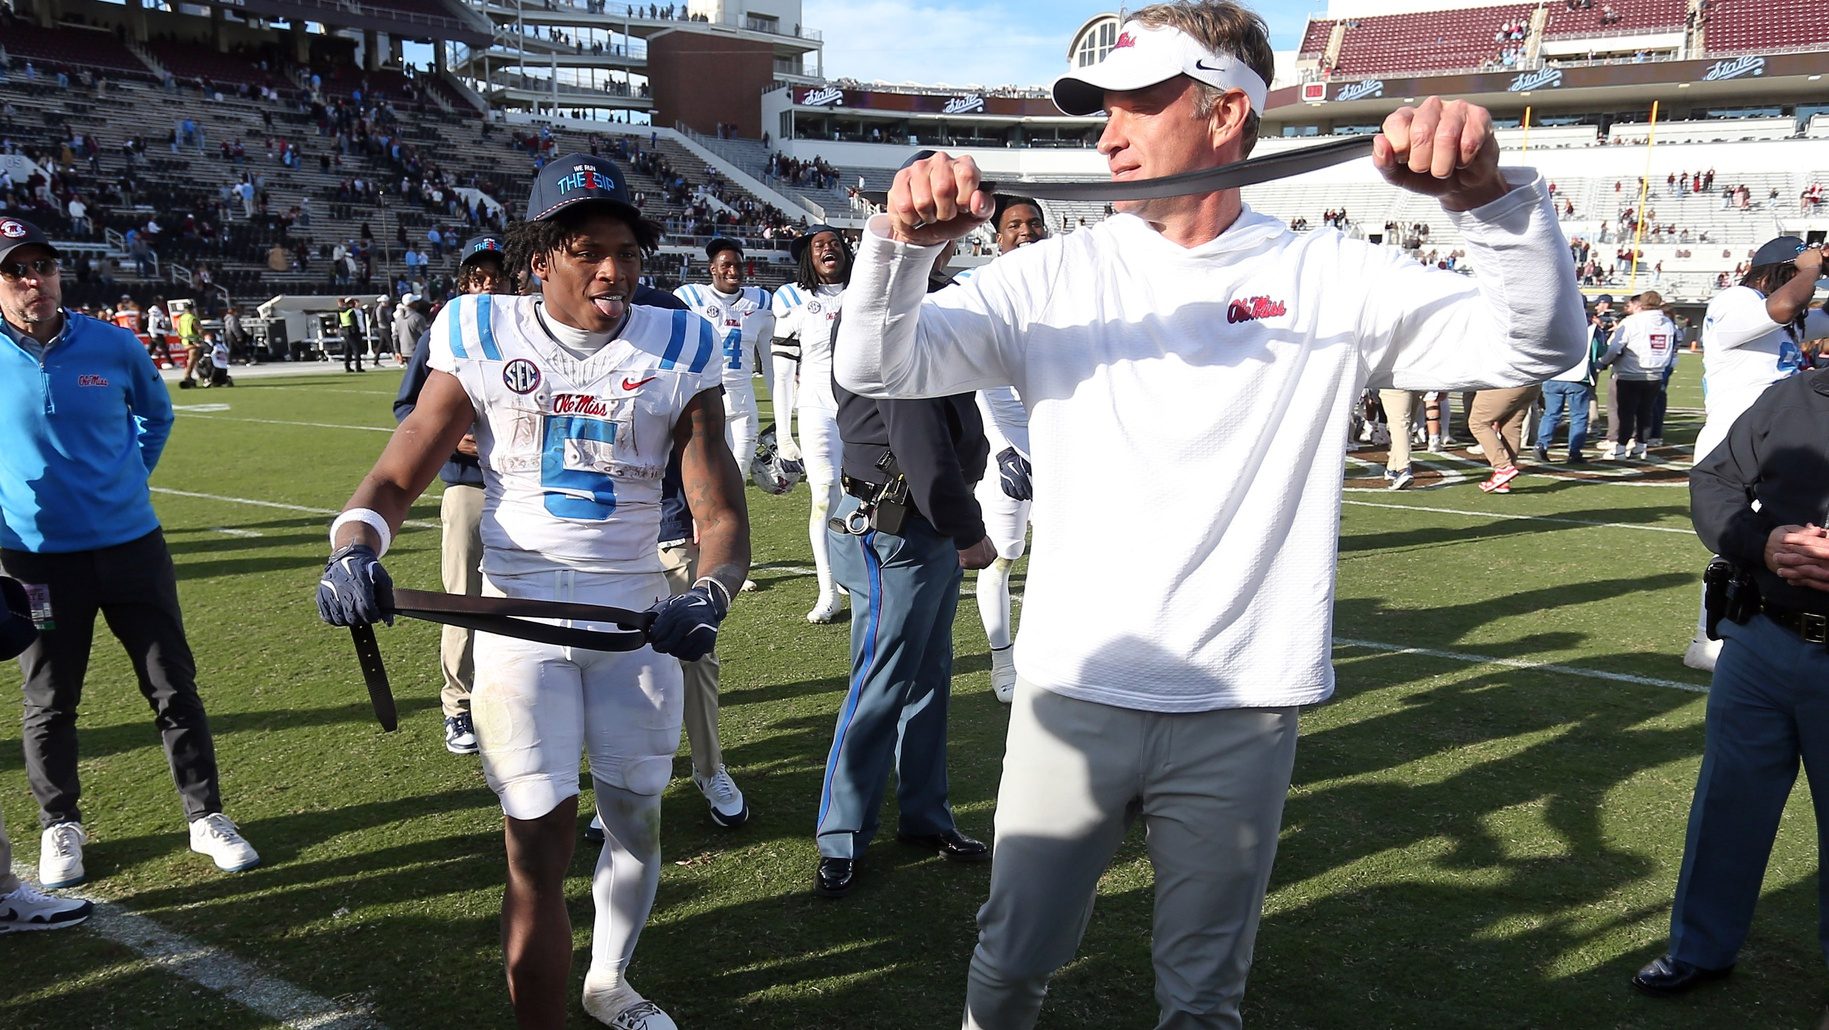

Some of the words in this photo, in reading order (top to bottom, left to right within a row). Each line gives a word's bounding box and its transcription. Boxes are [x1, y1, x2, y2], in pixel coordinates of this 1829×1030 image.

[1507, 68, 1562, 92] State
[1703, 56, 1765, 81] State
[802, 86, 843, 106] State
[1335, 80, 1384, 101] State
[942, 93, 984, 114] State
[573, 164, 584, 172] WE
[557, 171, 586, 195] THE
[592, 171, 615, 191] SIP
[1227, 298, 1251, 324] Ole
[1250, 295, 1287, 319] Miss
[722, 328, 743, 369] 4
[505, 360, 537, 392] SEC
[553, 393, 575, 413] Ole
[574, 394, 608, 416] Miss
[540, 414, 618, 521] 5
